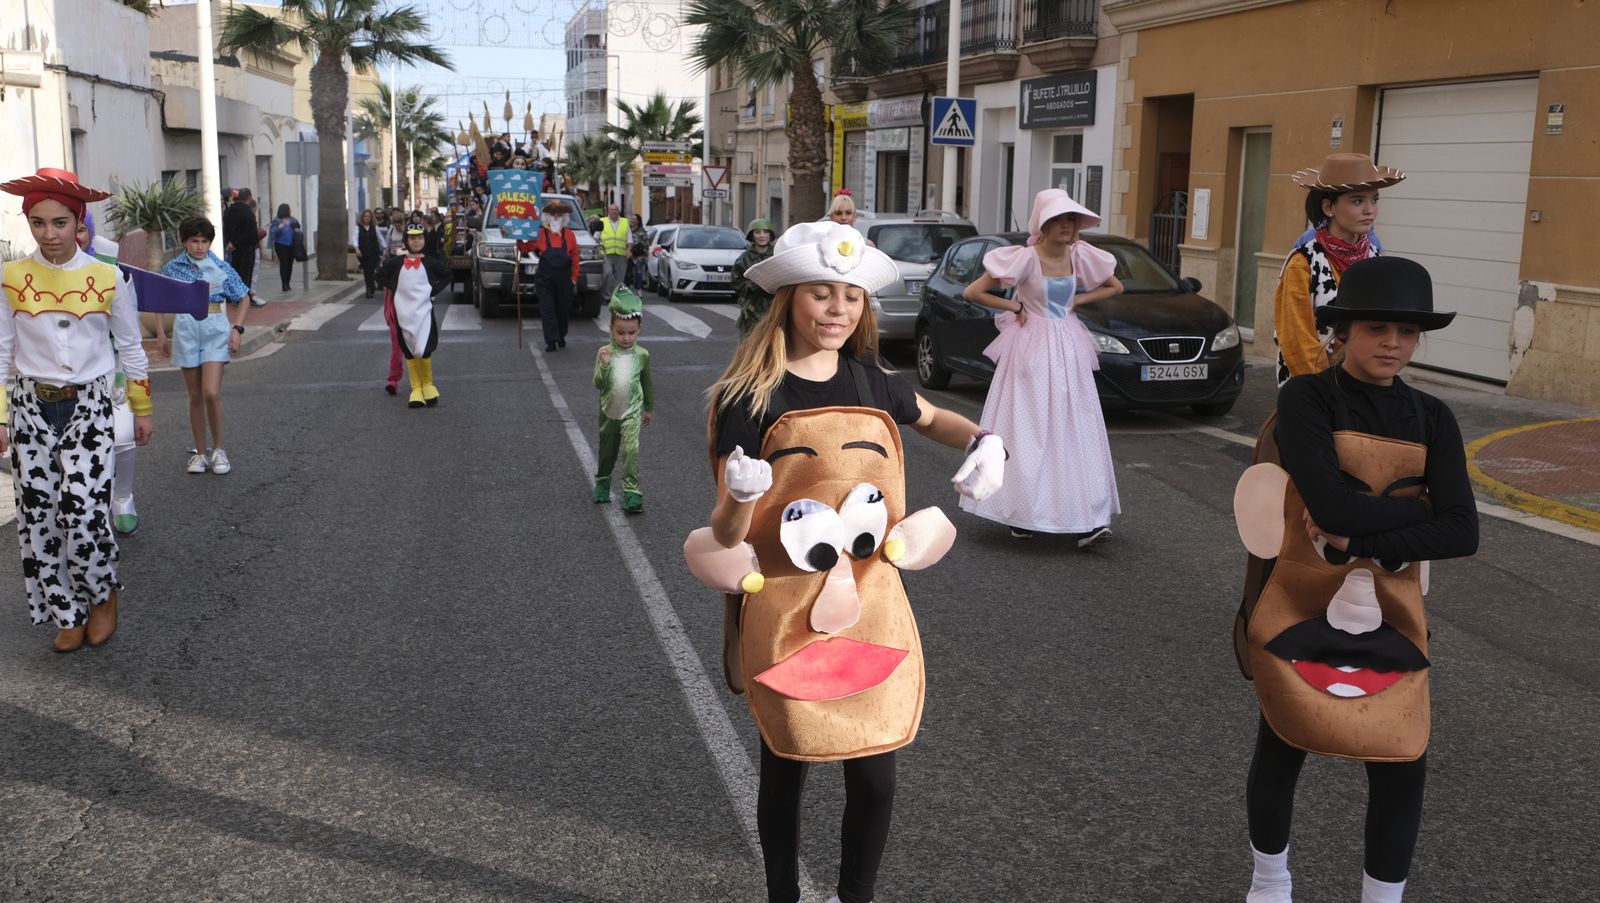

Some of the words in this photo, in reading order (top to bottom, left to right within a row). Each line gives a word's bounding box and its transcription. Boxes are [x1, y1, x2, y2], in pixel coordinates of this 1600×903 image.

[1033, 87, 1055, 100] BUFETE
[1046, 101, 1075, 110] ABOGADOS
[505, 204, 526, 214] TOYS
[1150, 366, 1179, 379] 5244
[1183, 366, 1205, 378] GSX
